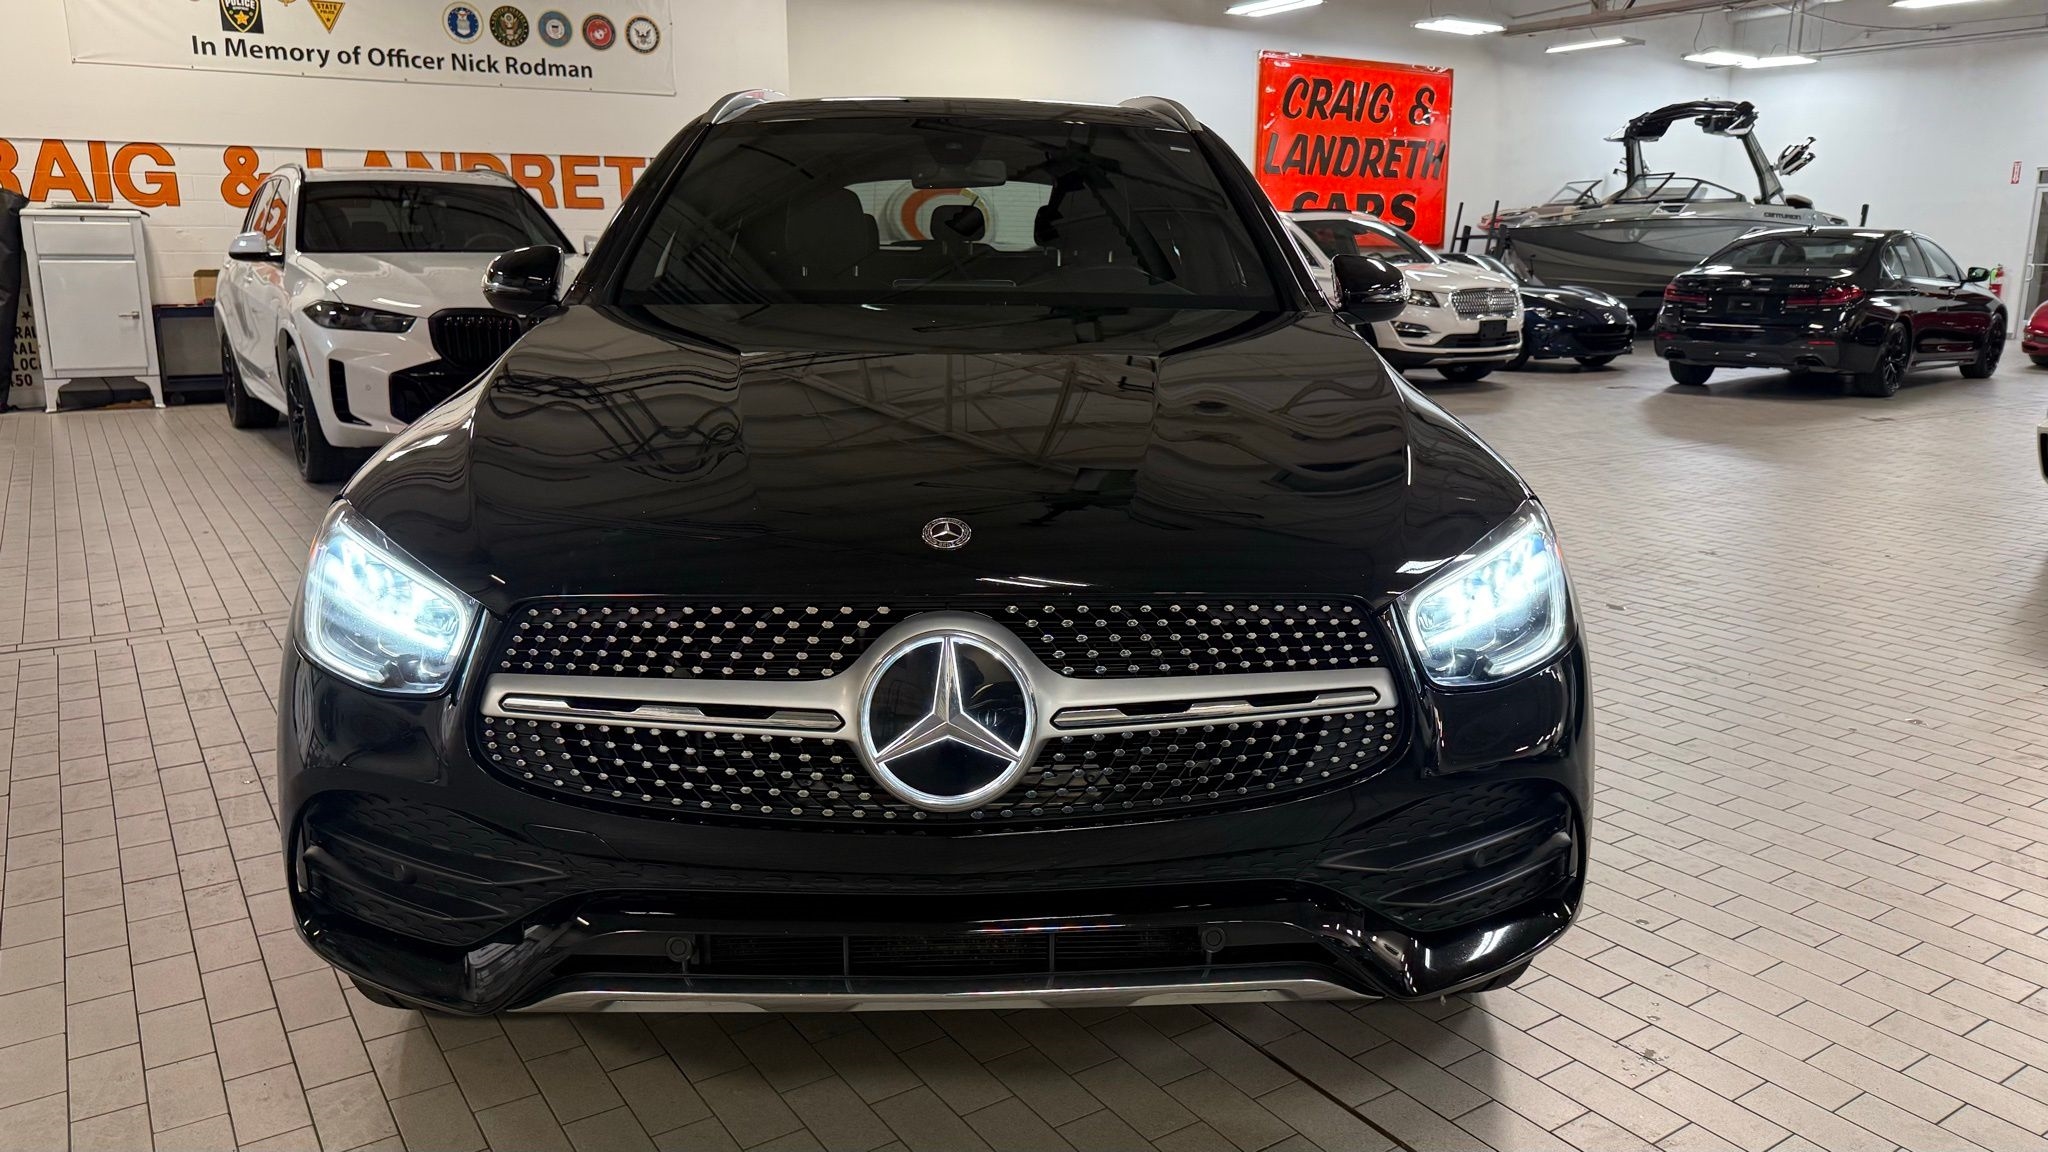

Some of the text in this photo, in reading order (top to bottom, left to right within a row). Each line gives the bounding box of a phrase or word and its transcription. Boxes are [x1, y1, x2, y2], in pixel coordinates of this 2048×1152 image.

[192, 35, 593, 78] In Memory of Officer Nick Rodman
[1282, 77, 1436, 125] CRAIG &
[221, 145, 273, 208] &
[1264, 133, 1447, 179] LANDRETH
